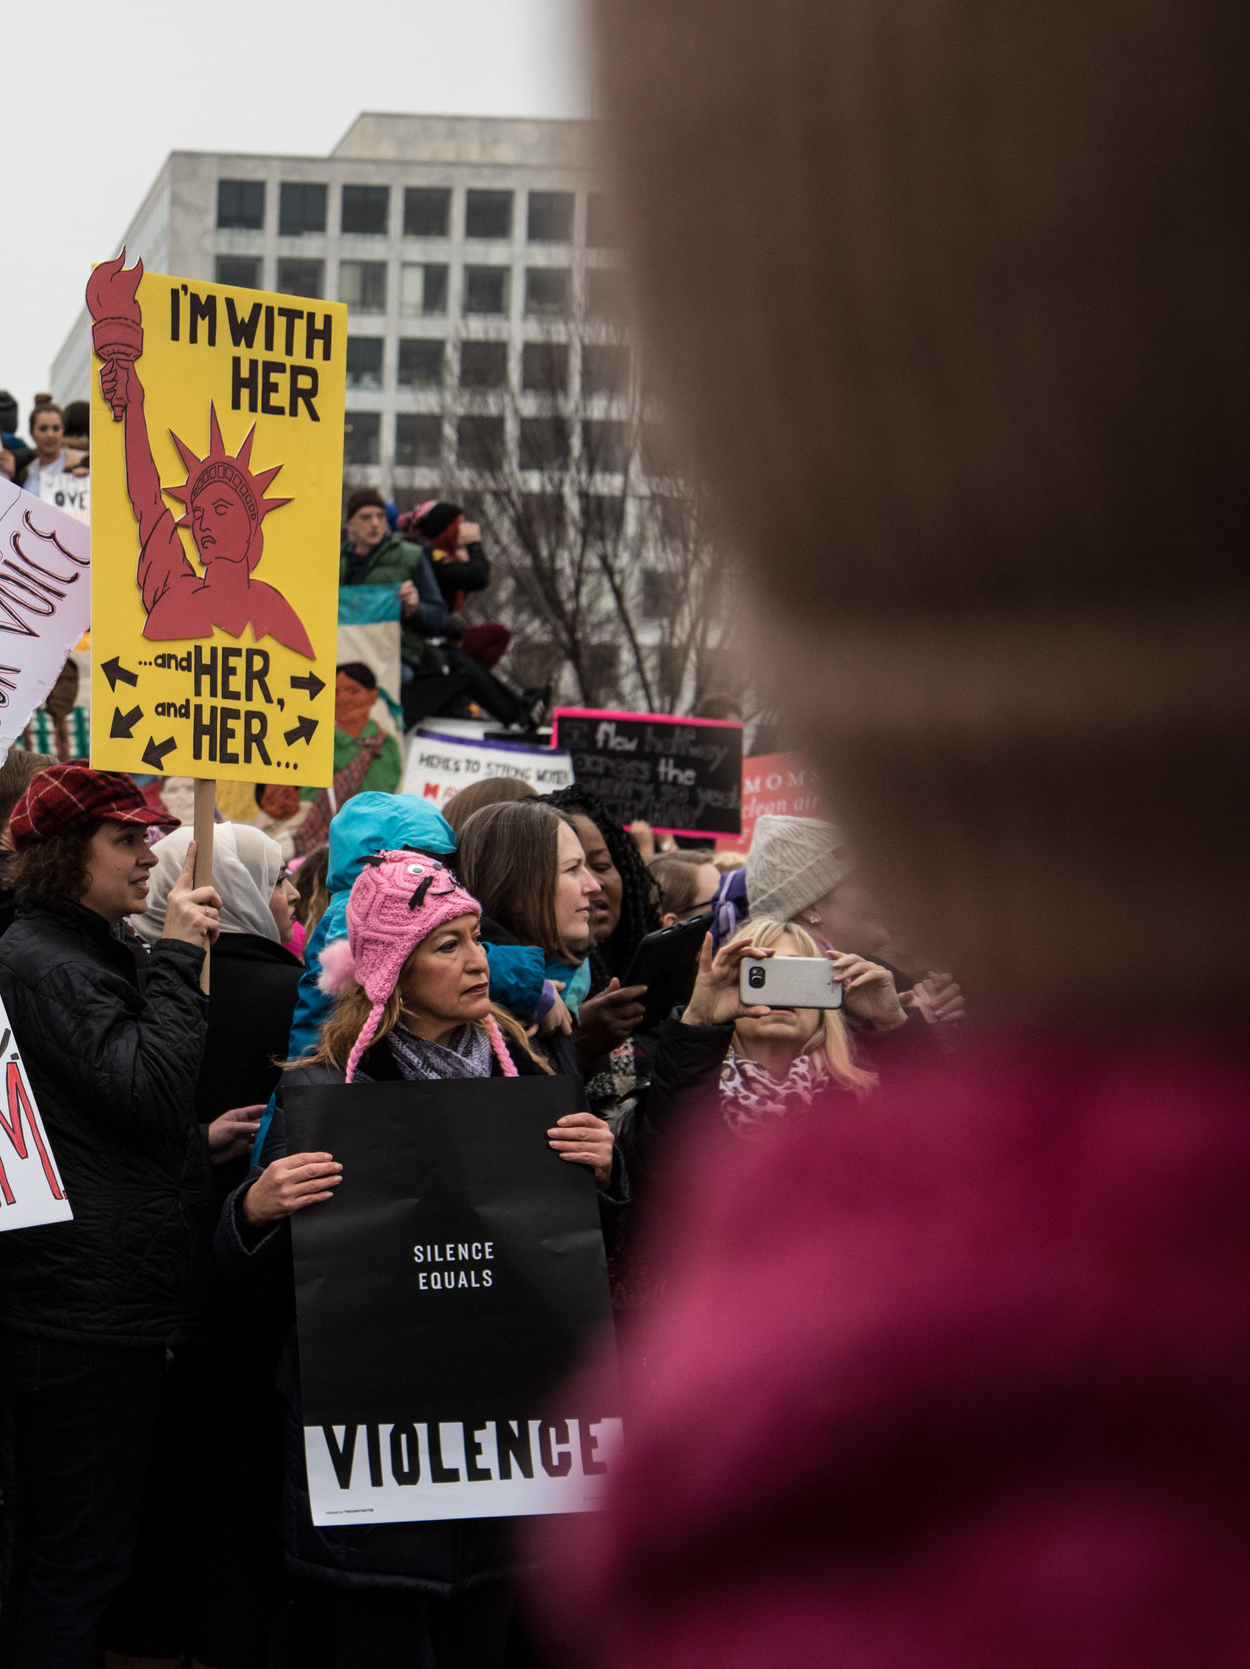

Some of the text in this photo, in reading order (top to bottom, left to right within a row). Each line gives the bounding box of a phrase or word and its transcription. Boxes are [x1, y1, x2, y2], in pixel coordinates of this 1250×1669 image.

[170, 283, 333, 361] I'M WITH
[231, 355, 320, 422] HER
[193, 644, 286, 713] HER,
[154, 698, 191, 720] and
[463, 759, 481, 773] TO
[485, 761, 533, 783] STRONG
[573, 753, 697, 786] across the
[413, 1241, 495, 1263] SILENCE
[418, 1269, 493, 1290] EQUALS
[322, 1420, 608, 1490] VIOLENCE
